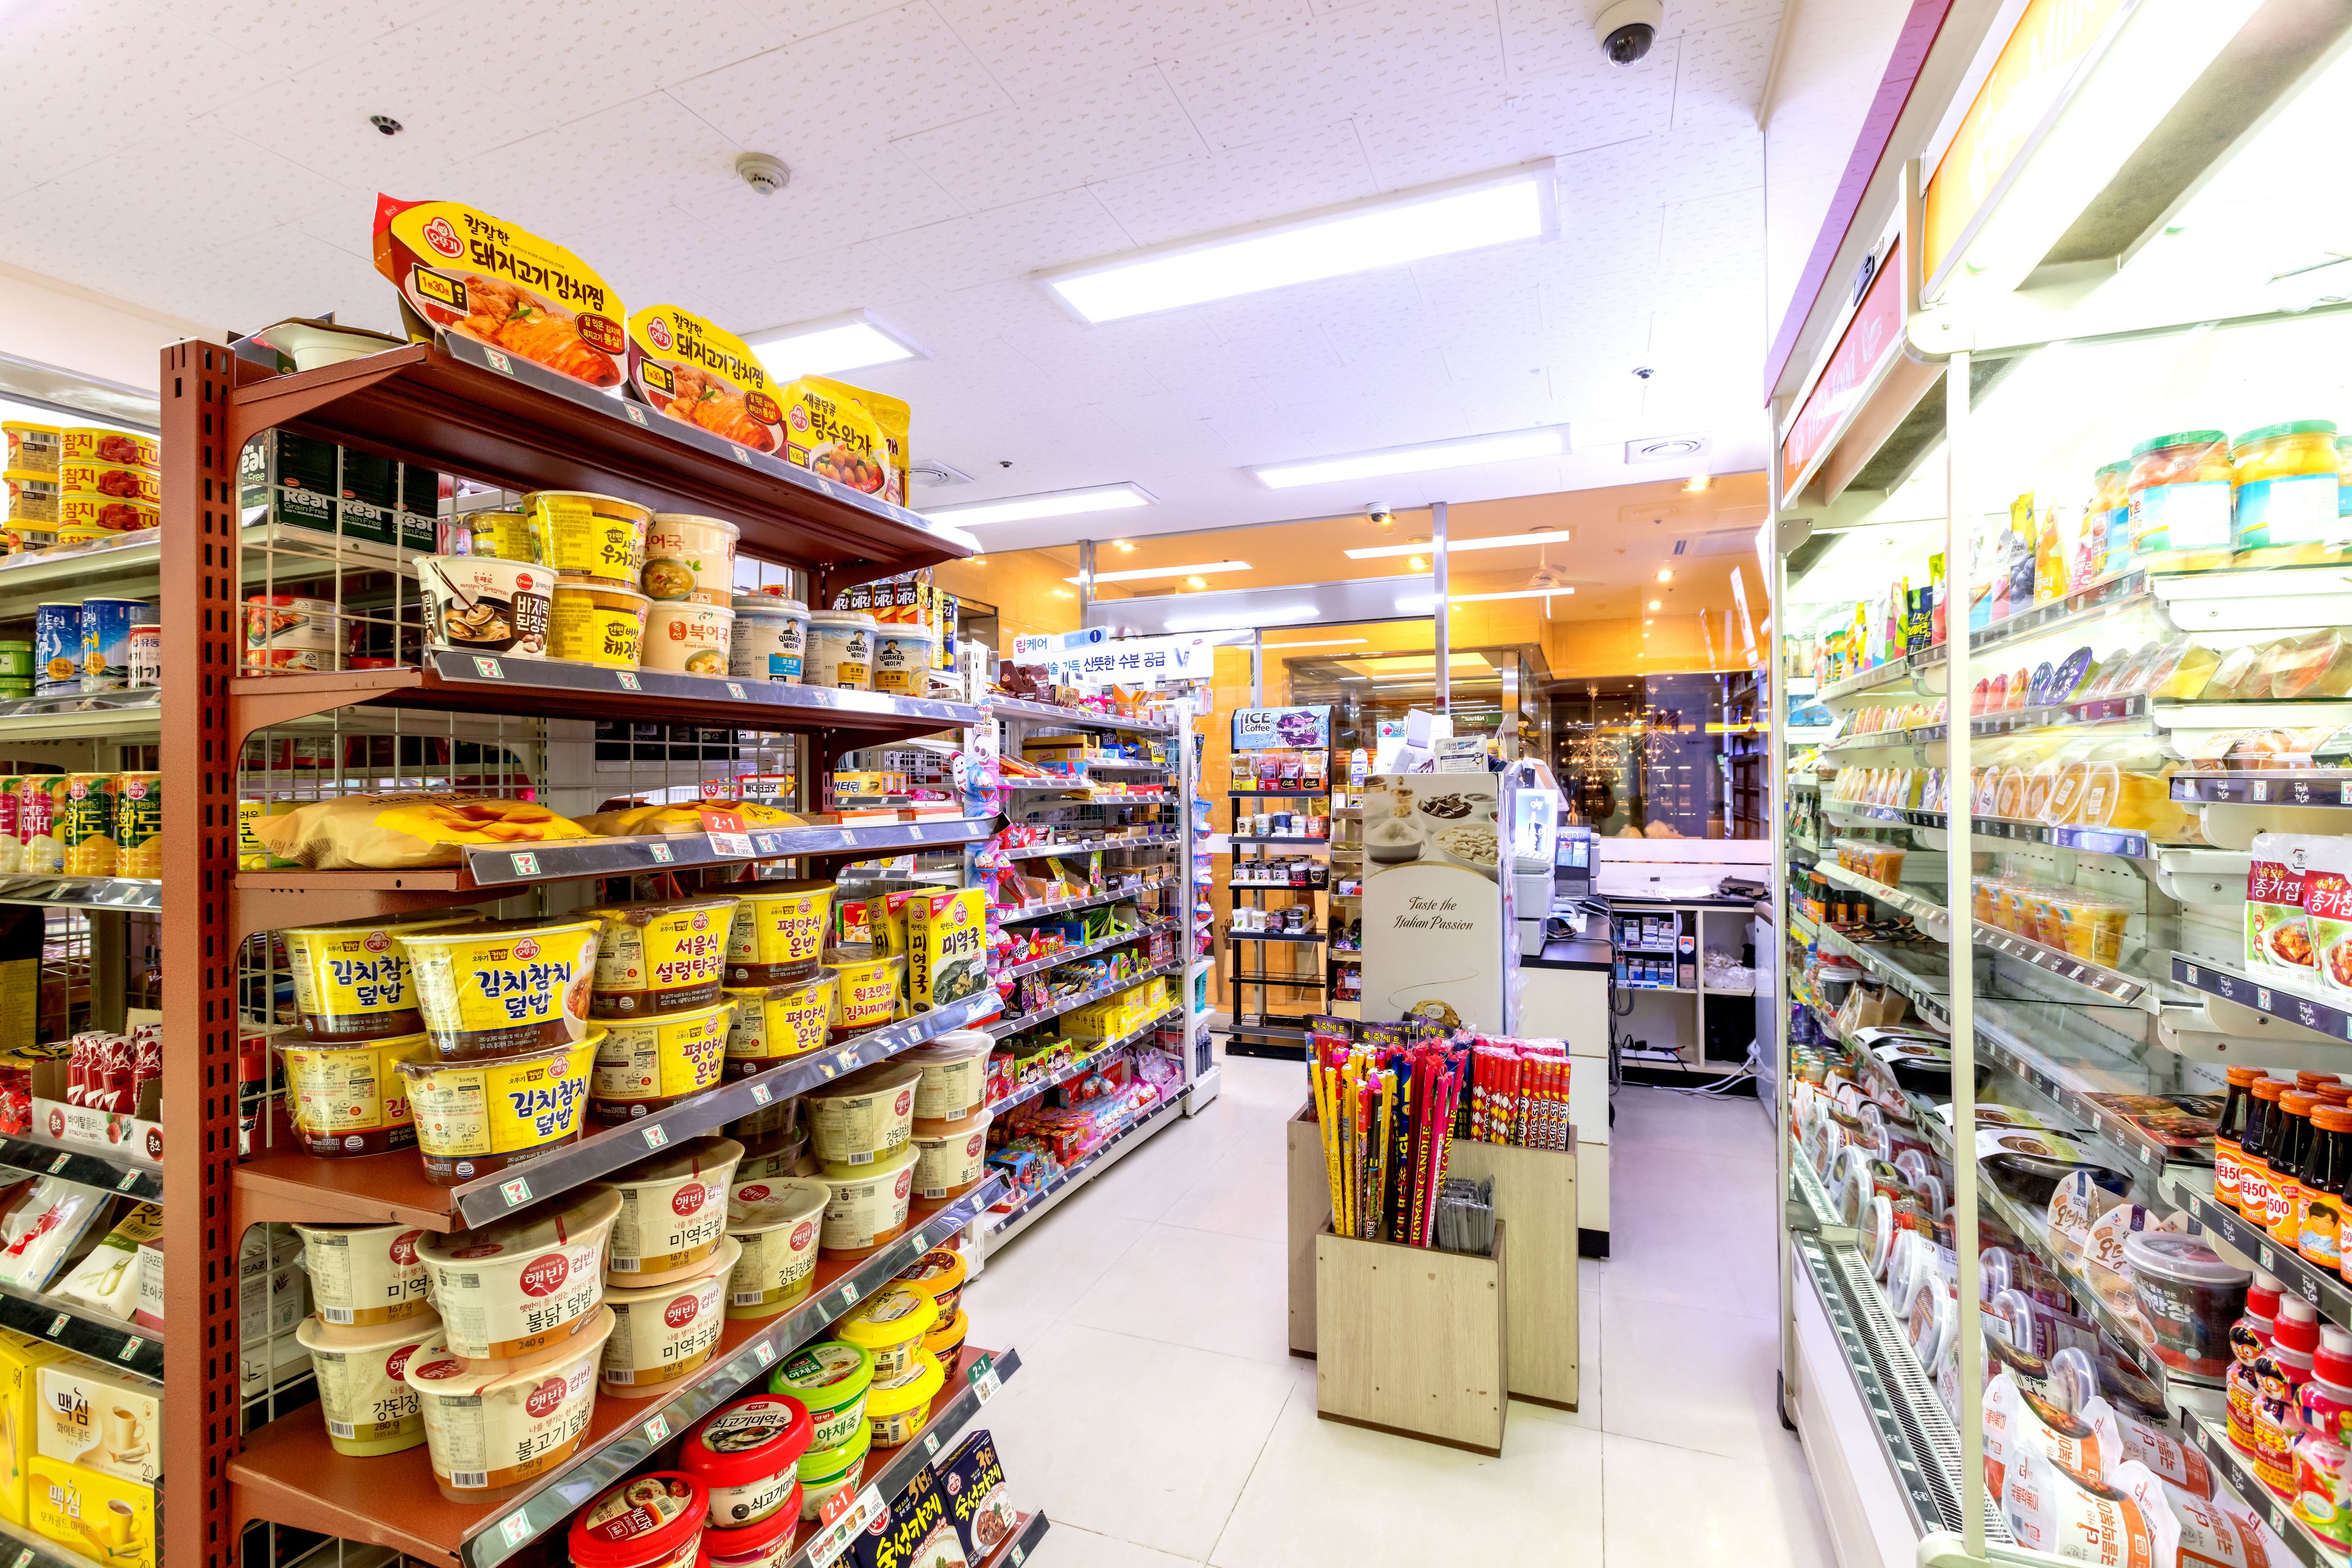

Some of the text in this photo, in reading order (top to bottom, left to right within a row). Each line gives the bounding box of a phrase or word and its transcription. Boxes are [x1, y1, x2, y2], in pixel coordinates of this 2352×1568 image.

[464, 214, 510, 246] 칼칼한
[673, 312, 703, 337] 칼칼한
[604, 334, 622, 349] 통살!
[802, 393, 836, 417] 새콤달콤
[810, 413, 872, 458] 탕수완자
[284, 490, 328, 510] Real
[284, 502, 328, 516] Grain Free
[363, 518, 382, 527] Free
[607, 532, 623, 542] 간편
[518, 595, 549, 617] 바지락
[874, 593, 894, 607] 예감
[897, 591, 916, 605] 예감
[516, 613, 548, 635] 된장국
[608, 625, 624, 636] 간편
[625, 626, 639, 639] 버섯
[673, 623, 682, 639] 즉석
[689, 624, 728, 644] 북어국
[1016, 638, 1047, 654] 립케어
[1084, 655, 1115, 671] 산뜻한
[1118, 653, 1140, 668] 수분
[1144, 651, 1166, 667] 공급
[1245, 712, 1272, 723] ICE
[2222, 790, 2230, 799] Go
[2301, 791, 2309, 803] Go
[1409, 896, 1457, 911] Taste the
[777, 914, 821, 938] 평양식
[941, 922, 954, 930] 맛있는
[1392, 915, 1474, 930] Italian Passion
[675, 933, 718, 956] 서울식
[789, 935, 816, 958] 온반
[942, 927, 979, 955] 미역국
[491, 951, 507, 960] 컵밥
[912, 933, 929, 994] 미역국
[655, 954, 725, 983] 설렁탕국밥
[474, 962, 570, 998] 김치참치
[854, 982, 892, 1002] 원조맛집
[2226, 986, 2233, 997] Go
[505, 992, 552, 1019] 덮밥
[845, 998, 894, 1021] 김치찌개밥
[786, 1003, 826, 1030] 평양식
[2306, 1014, 2315, 1027] Go
[797, 1025, 821, 1049] 온반
[1311, 1020, 1346, 1035] 폭죽세트
[1362, 1030, 1401, 1044] 폭죽세트
[682, 1032, 725, 1064] 평양식
[529, 1071, 542, 1080] 컵밥
[695, 1057, 720, 1086] 온반
[509, 1075, 586, 1118] 김치참치
[50, 1115, 62, 1132] 홍초
[67, 1114, 103, 1131] 바이탈플러스
[536, 1107, 573, 1137] 덮밥
[1442, 1109, 1458, 1167] CANDLE
[1539, 1118, 1547, 1148] SUPER
[148, 1136, 160, 1152] 홍초
[1412, 1126, 1431, 1241] ROMAN CANDLE
[674, 1190, 703, 1212] 햇반
[2224, 1193, 2239, 1204] 500mg
[674, 1219, 685, 1229] 나를
[2247, 1210, 2261, 1221] 500mg
[669, 1214, 723, 1249] 미역국밥
[571, 1249, 595, 1273] 컵반
[524, 1264, 565, 1292] 햇반
[520, 1282, 586, 1313] 햇반이 가정식
[700, 1287, 719, 1310] 컵반
[526, 1286, 593, 1333] 불닭 덮밥
[667, 1302, 696, 1324] 햇반
[663, 1319, 719, 1360] 미역국밥
[667, 1325, 696, 1341] 나를 챙기는
[519, 1339, 535, 1349] 240
[568, 1365, 590, 1392] 컵반
[663, 1364, 676, 1373] 167
[788, 1364, 820, 1378] 야채죽
[973, 1359, 989, 1379] 2+1
[58, 1387, 89, 1426] 맥심
[374, 1421, 391, 1431] 280
[546, 1414, 564, 1427] 챙기는
[710, 1414, 786, 1429] 쇠고기미역죽
[817, 1414, 857, 1441] 야채죽
[57, 1422, 91, 1442] 화이트골드
[516, 1422, 565, 1461] 불고기
[142, 1463, 154, 1479] 20
[517, 1460, 534, 1472] 250
[48, 1480, 82, 1518] 맥심
[955, 1464, 1002, 1523] 숙성카레
[827, 1491, 848, 1519] 2+1
[40, 1512, 92, 1536] 모카골드 마일드
[876, 1492, 943, 1568] 숙성카레
[679, 1540, 693, 1556] 양반
